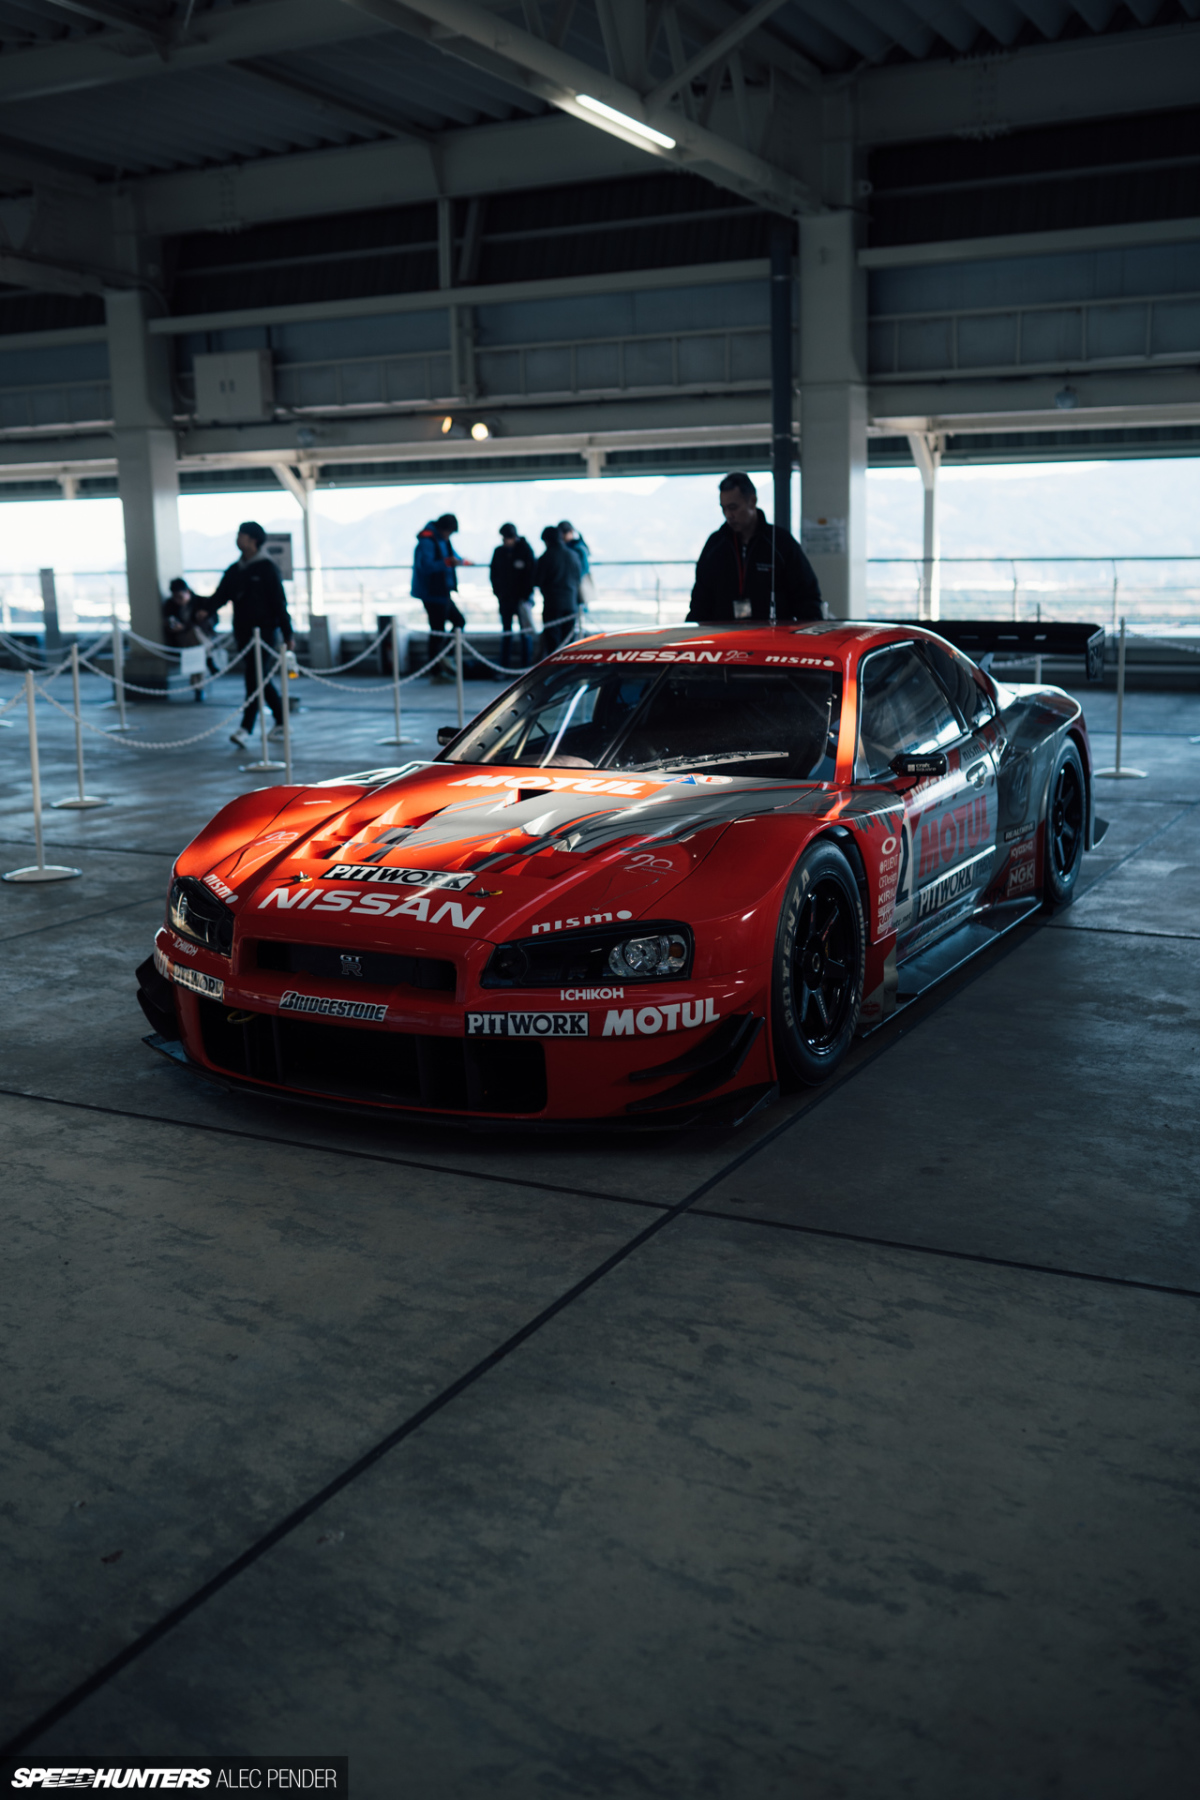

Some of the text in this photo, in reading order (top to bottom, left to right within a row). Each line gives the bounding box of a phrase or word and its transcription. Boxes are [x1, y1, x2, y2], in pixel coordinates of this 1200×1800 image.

[606, 650, 723, 663] NISSAN
[765, 655, 835, 667] nismo
[447, 774, 646, 796] MOTUL
[918, 794, 990, 879] MOTUL
[1009, 862, 1034, 888] NGK
[203, 873, 239, 904] nismo
[257, 888, 486, 930] NISSAN
[531, 910, 633, 934] nismo
[278, 990, 389, 1022] BRIDGESTONE
[560, 987, 625, 1001] ICHIKOH
[602, 997, 720, 1036] MOTUL
